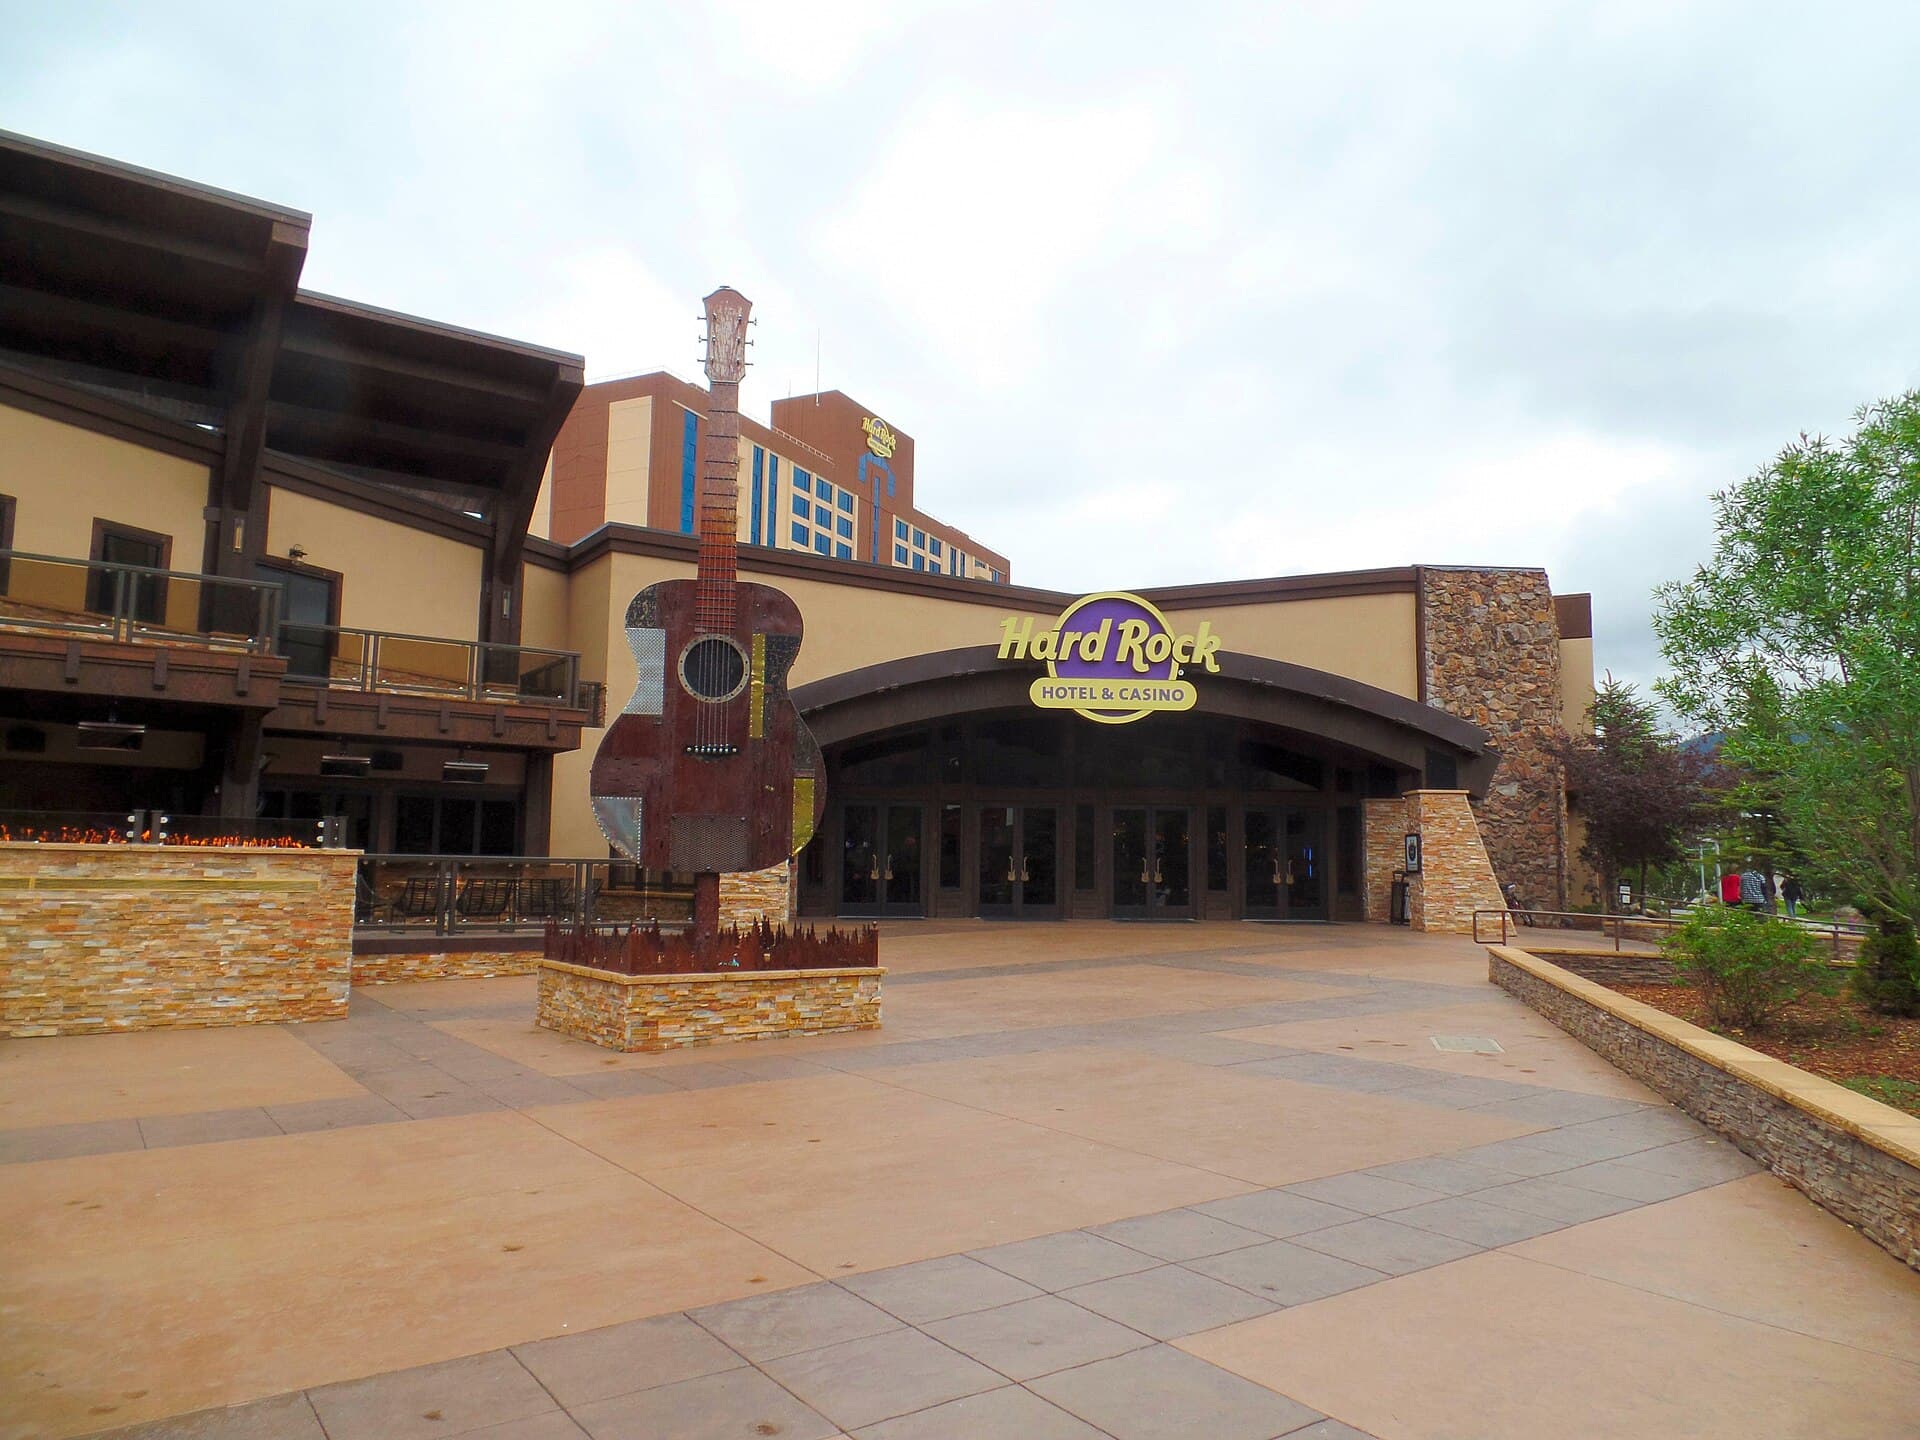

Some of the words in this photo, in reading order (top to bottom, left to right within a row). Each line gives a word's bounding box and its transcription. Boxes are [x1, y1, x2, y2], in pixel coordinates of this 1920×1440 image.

[996, 616, 1112, 662] Hard
[1115, 618, 1222, 673] Rock
[1041, 686, 1097, 700] HOTEL
[1101, 687, 1114, 700] &
[1118, 687, 1185, 702] CASINO
